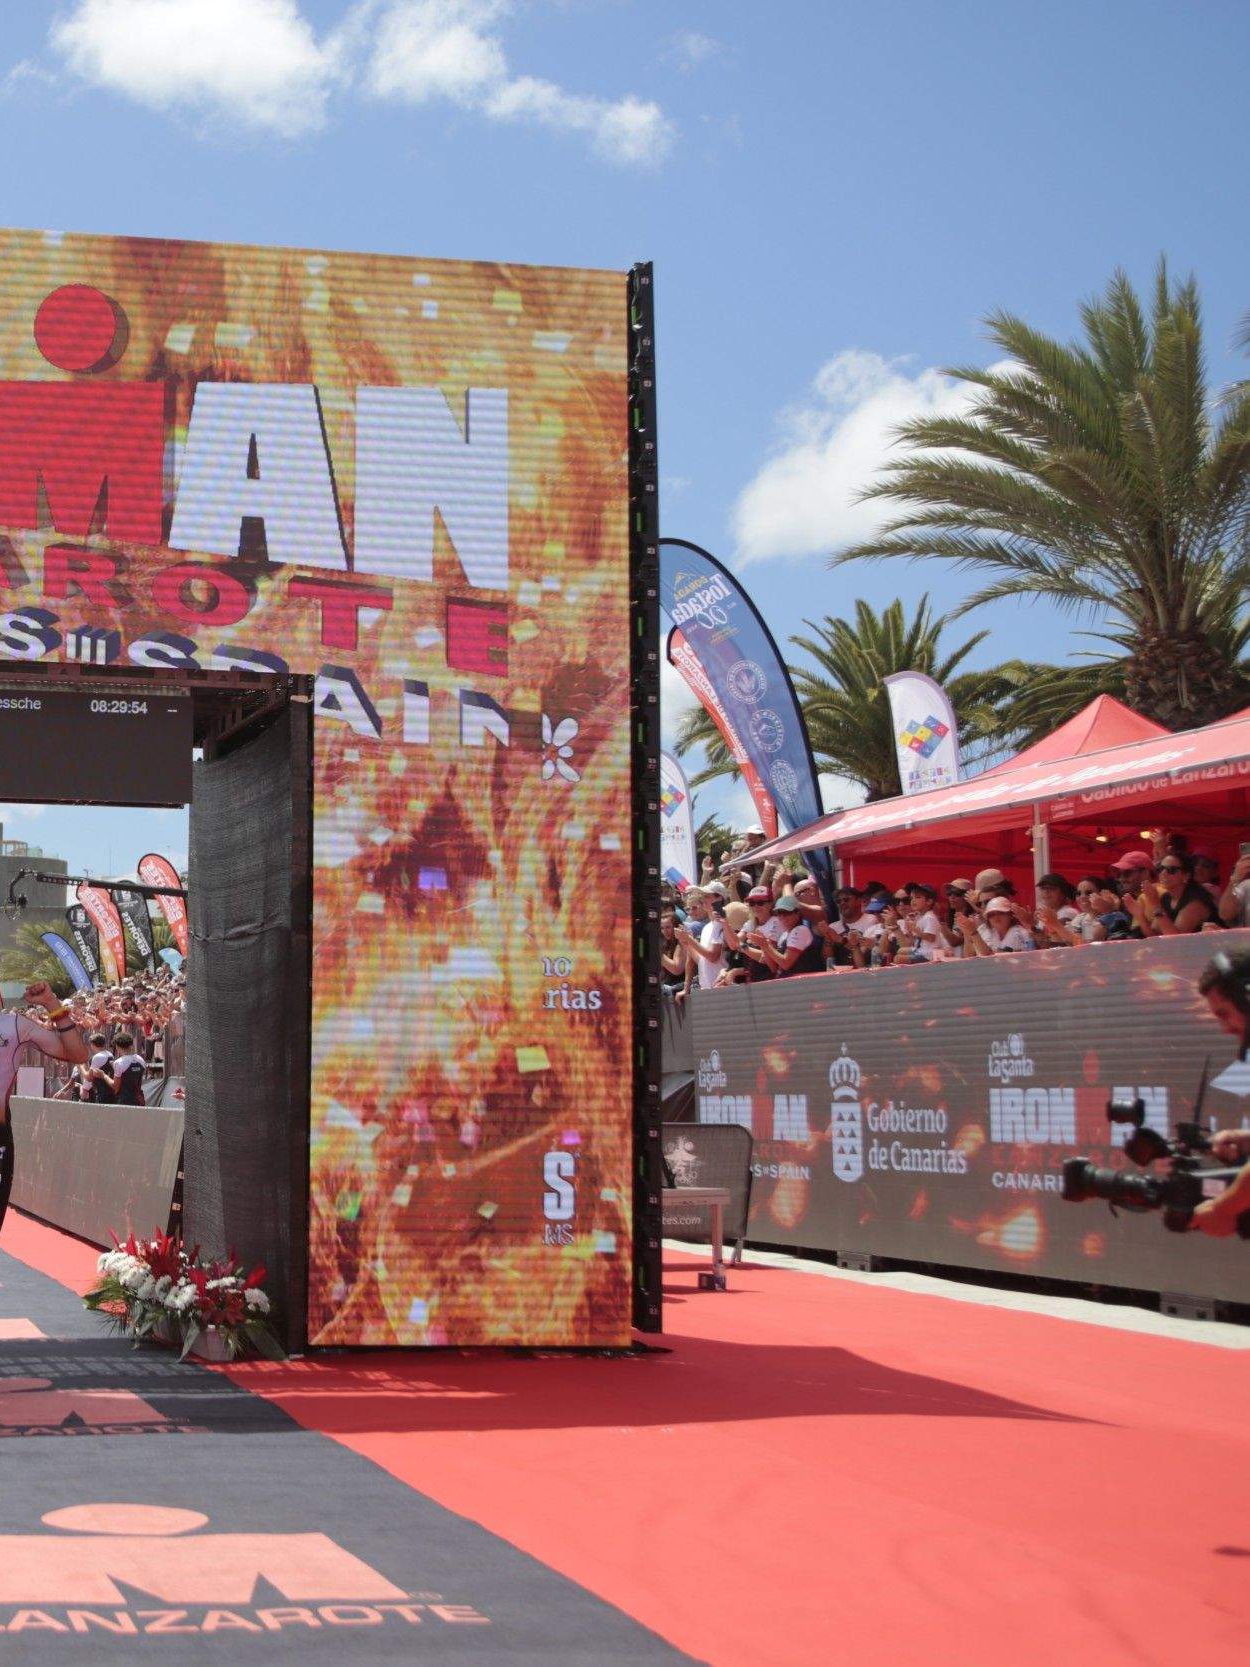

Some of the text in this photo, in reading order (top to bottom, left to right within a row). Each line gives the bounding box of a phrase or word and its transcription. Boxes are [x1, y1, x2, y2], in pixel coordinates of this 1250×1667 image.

[90, 700, 148, 714] 08:29:54
[867, 1100, 947, 1133] Gobierno
[868, 1138, 968, 1174] de Canarias
[769, 1163, 810, 1180] SPAIN
[991, 1171, 1064, 1193] CANARI
